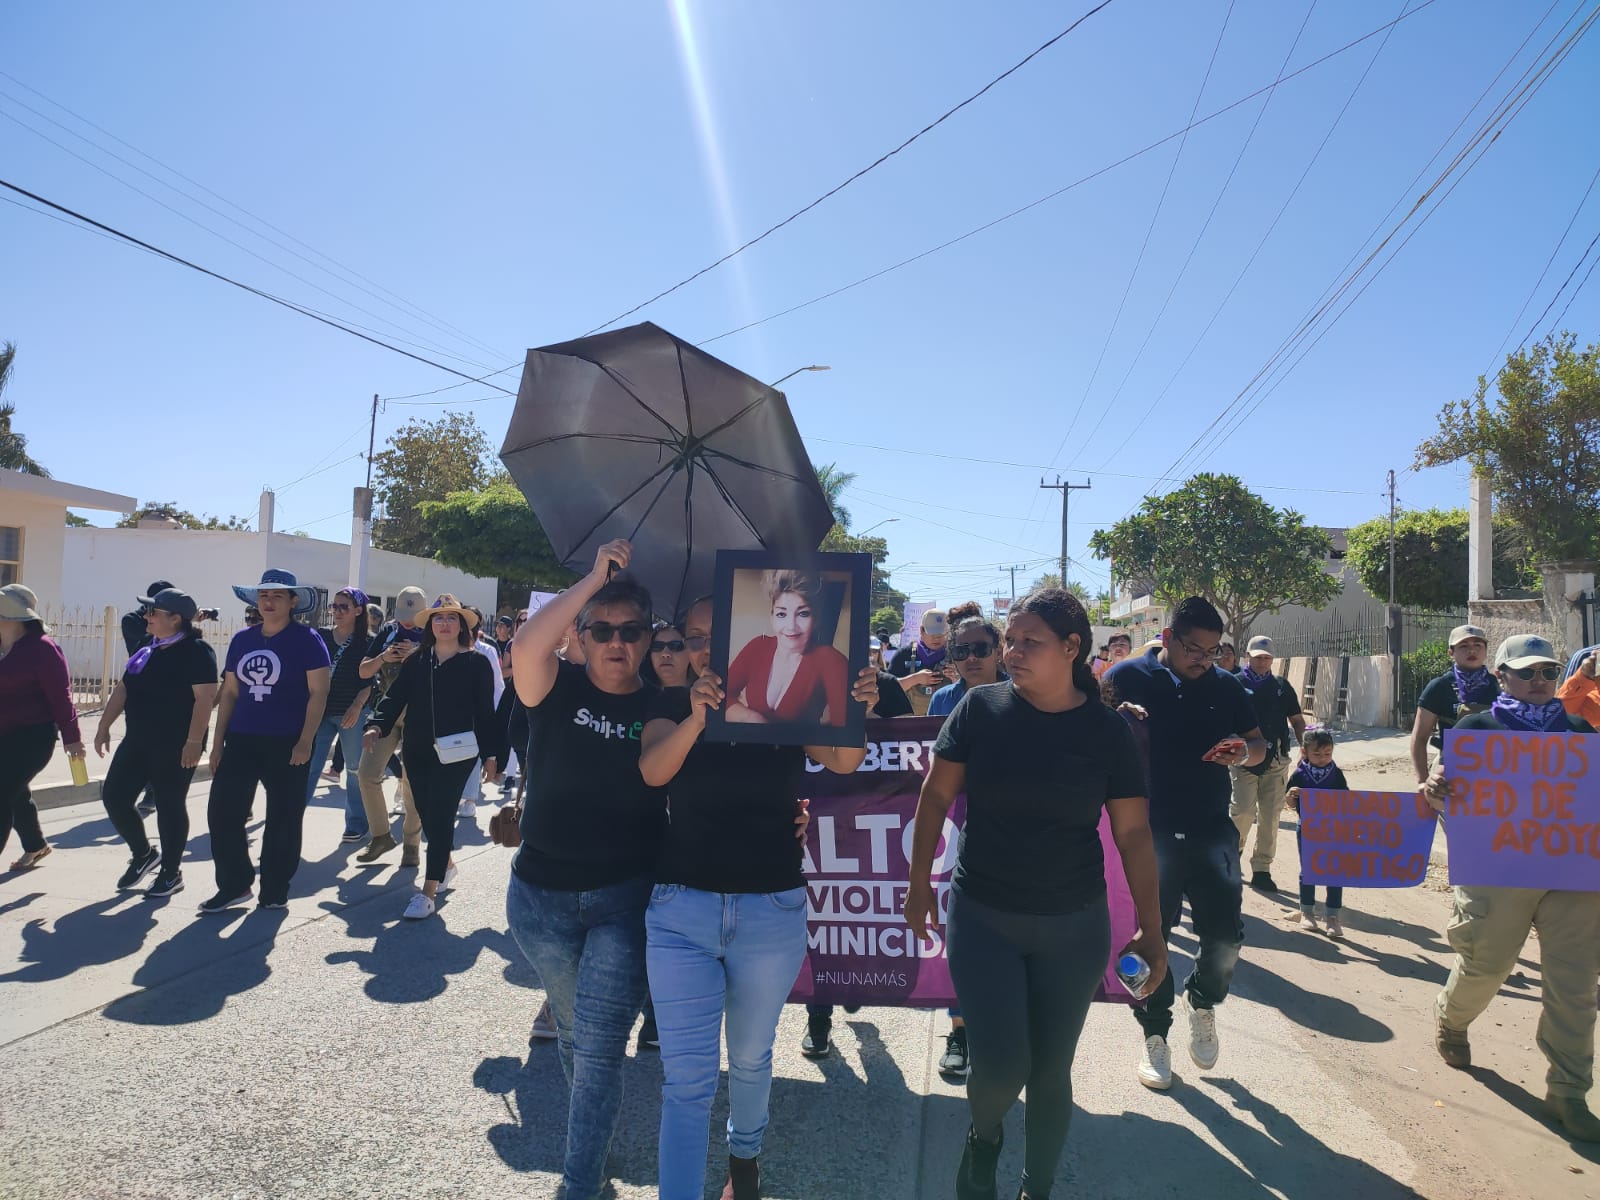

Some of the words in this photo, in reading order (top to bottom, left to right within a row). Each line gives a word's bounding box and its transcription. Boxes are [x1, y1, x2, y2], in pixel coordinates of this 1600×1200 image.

[1453, 735, 1590, 779] SOMOS
[1302, 790, 1401, 819] UNIDAD
[1449, 778, 1518, 818] RED
[1532, 780, 1578, 819] DE
[1301, 817, 1402, 849] GENERO
[1311, 849, 1425, 882] CONTIGO
[815, 970, 907, 987] #NIUNAMÁS
